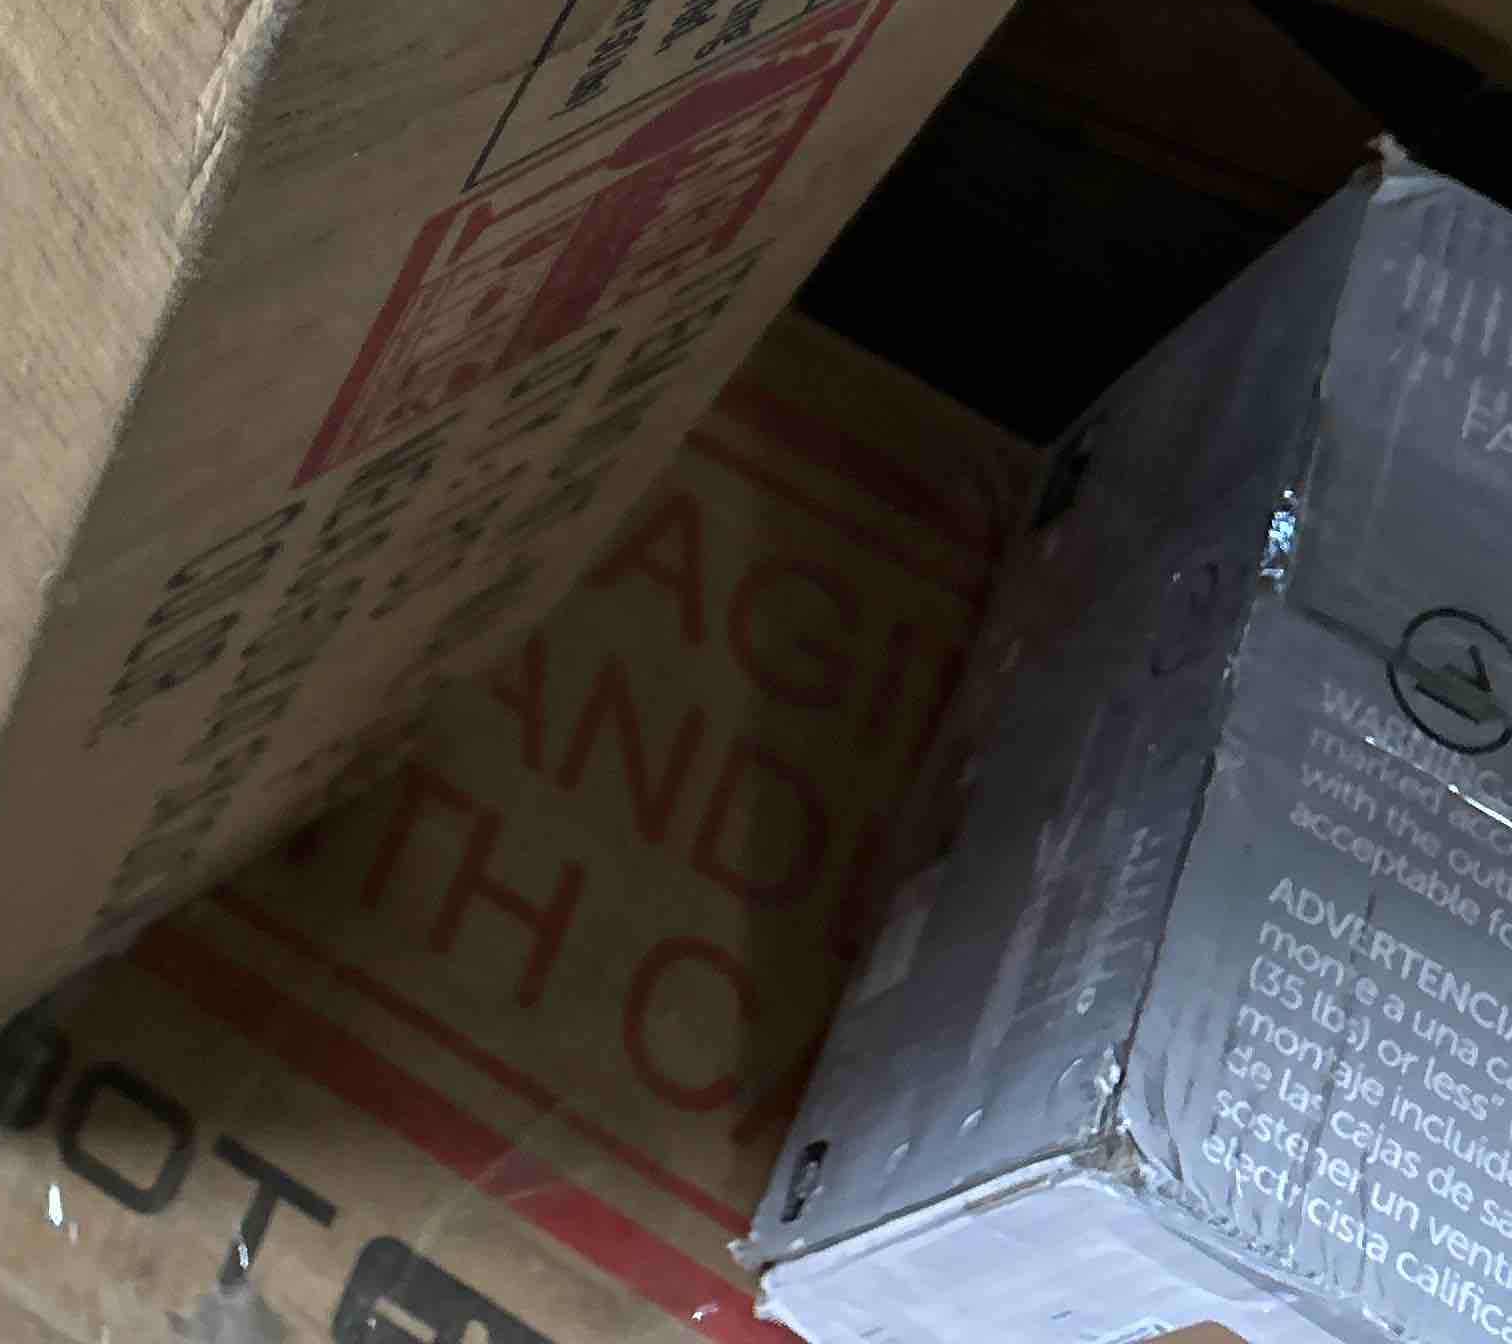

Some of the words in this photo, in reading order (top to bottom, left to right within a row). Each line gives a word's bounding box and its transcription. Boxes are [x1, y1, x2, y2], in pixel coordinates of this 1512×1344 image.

[1299, 762, 1379, 823] with
[1383, 805, 1443, 859] the
[1310, 727, 1442, 815] marked
[1289, 800, 1481, 926] acceptable
[1248, 953, 1307, 1012] (35
[1377, 1037, 1420, 1076] or
[1383, 993, 1406, 1023] a
[1412, 1009, 1480, 1068] una
[1226, 1043, 1275, 1090] de
[1329, 1109, 1421, 1180] cajas
[1427, 1164, 1474, 1211] de
[1369, 1182, 1420, 1231] un
